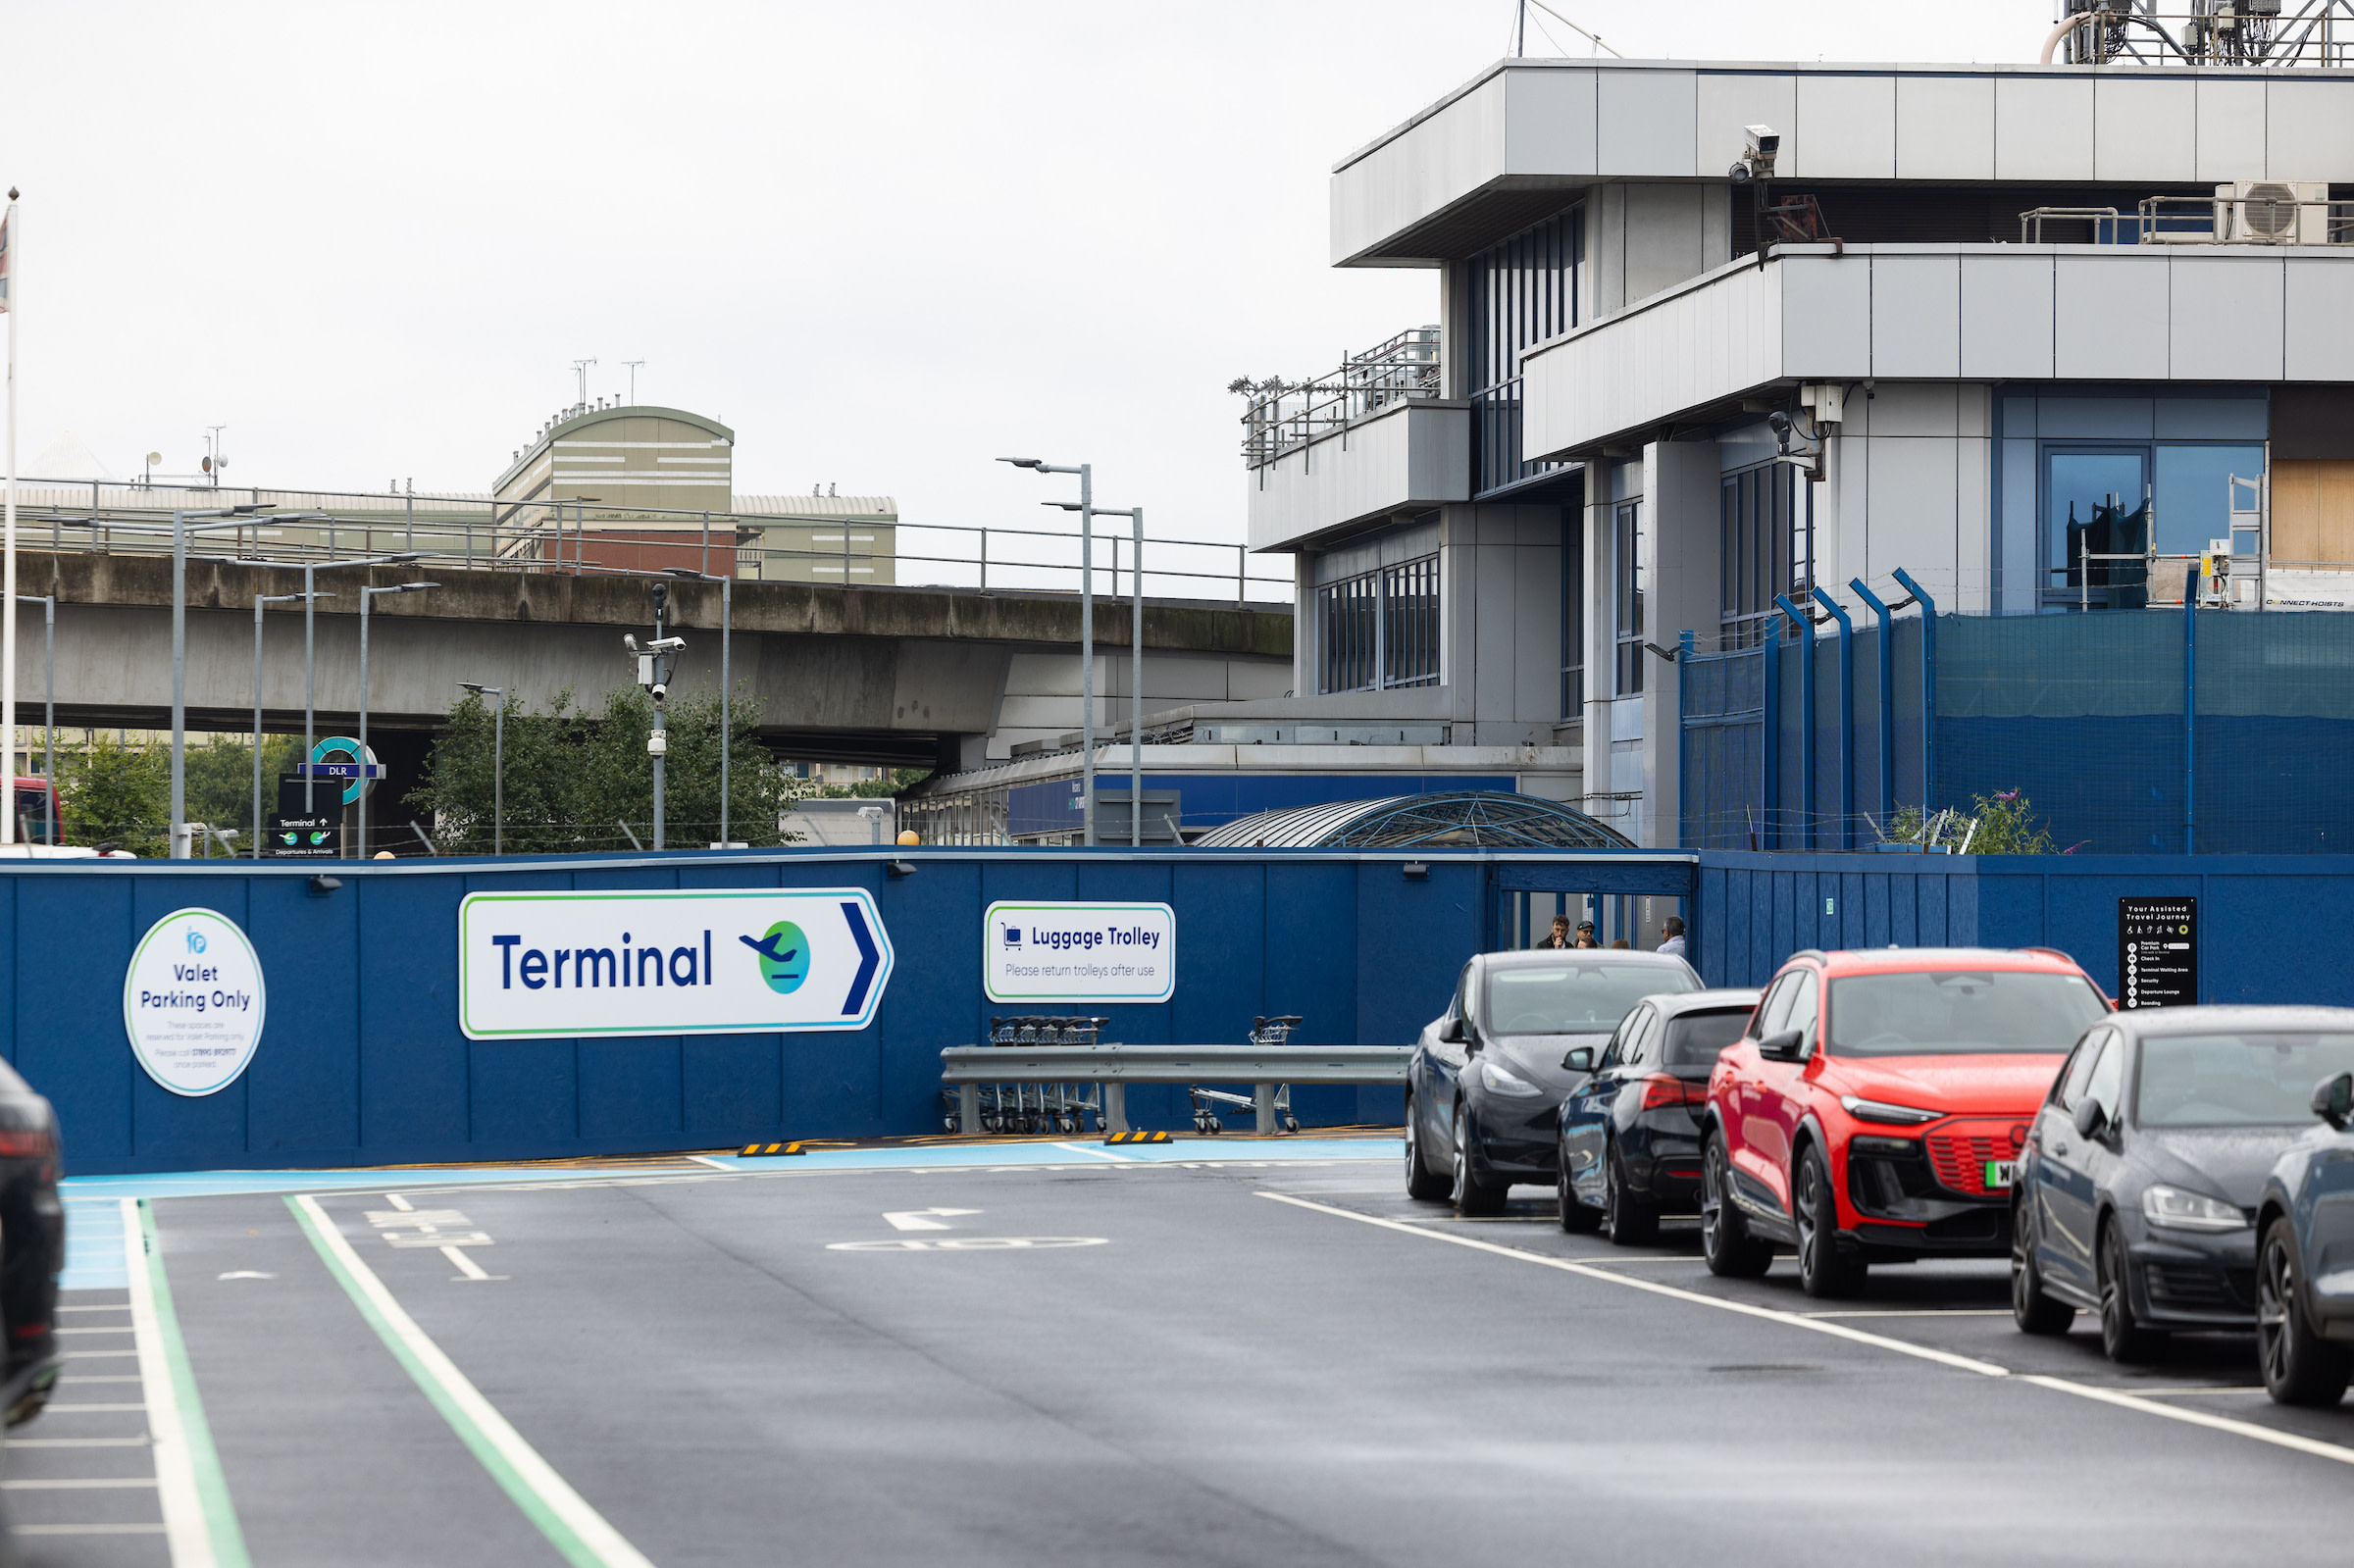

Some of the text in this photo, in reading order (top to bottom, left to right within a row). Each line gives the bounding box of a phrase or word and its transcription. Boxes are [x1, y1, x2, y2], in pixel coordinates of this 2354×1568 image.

[329, 767, 347, 776] DLR
[280, 818, 316, 828] Terminal
[1033, 927, 1160, 950] Luggage Trolley
[492, 929, 712, 990] Terminal
[174, 963, 219, 982] Valet
[1005, 963, 1154, 980] Please return trolleys after use
[141, 989, 251, 1013] Parking Only
